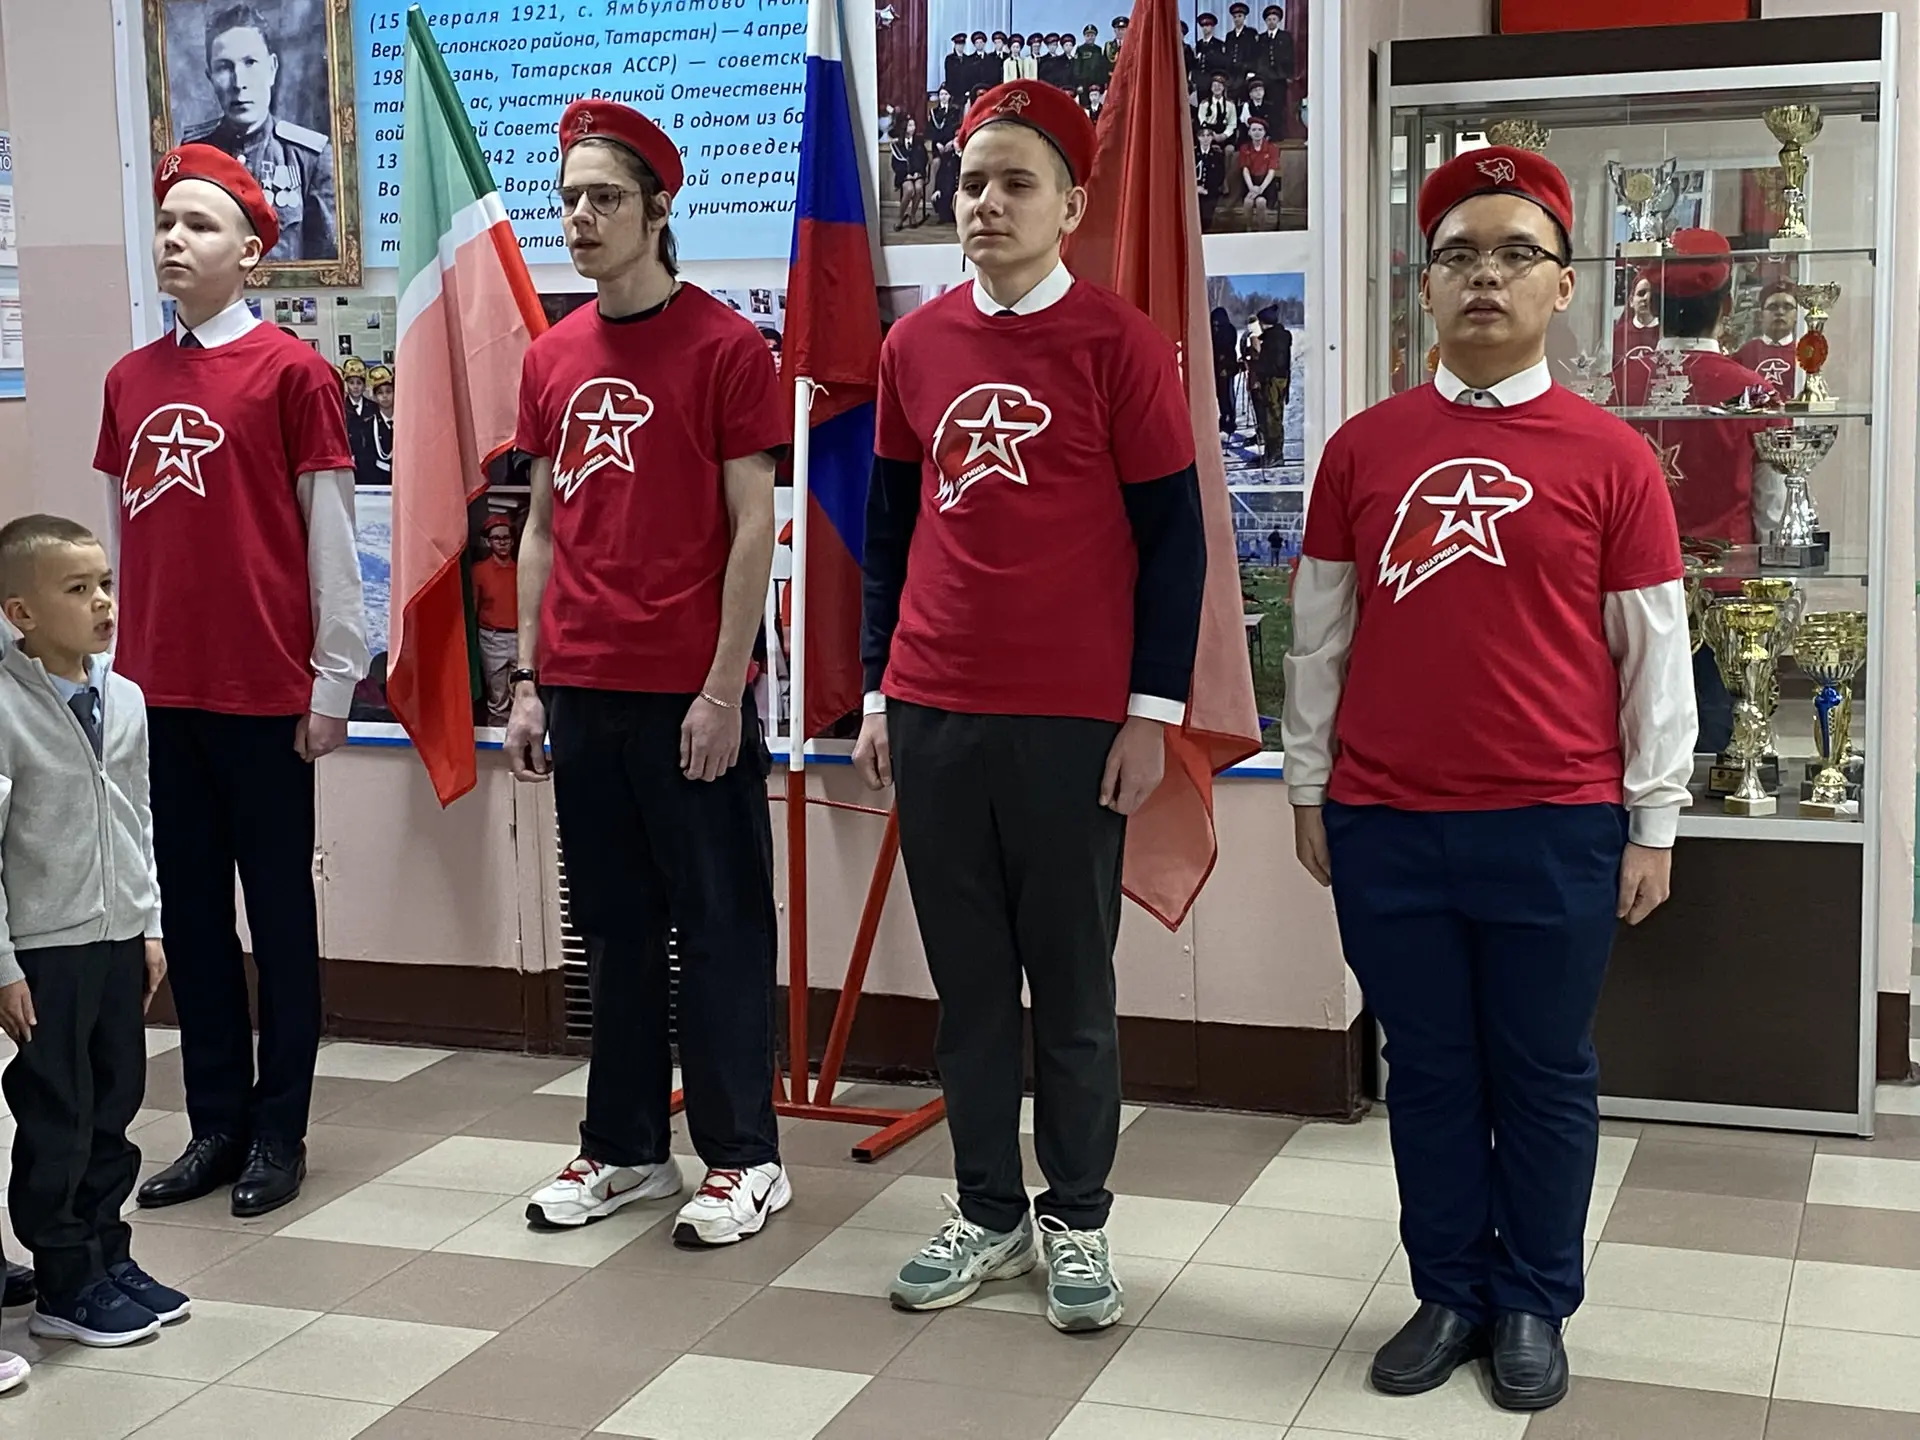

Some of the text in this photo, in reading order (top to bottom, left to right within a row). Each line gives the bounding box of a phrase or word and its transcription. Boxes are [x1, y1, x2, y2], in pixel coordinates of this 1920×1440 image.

[370, 13, 400, 34] (15
[428, 10, 499, 29] евраля
[511, 4, 565, 22] 1921,
[578, 6, 593, 17] с.
[606, 0, 745, 17] Ямбулатово
[531, 33, 599, 53] района,
[605, 22, 717, 46] Татарстан)
[744, 21, 754, 37] 4
[373, 70, 404, 86] 198
[453, 67, 499, 83] зань,
[511, 61, 612, 81] Татарская
[623, 53, 677, 75] АССР)
[470, 96, 493, 111] ас,
[591, 84, 664, 102] Великой
[671, 80, 806, 100] Отечественн
[375, 121, 404, 141] вой
[494, 120, 560, 138] Советс
[673, 113, 685, 129] В
[690, 111, 750, 128] одном
[757, 113, 776, 126] из
[783, 107, 805, 126] бо
[376, 153, 398, 169] 13
[484, 149, 515, 165] 942
[526, 145, 560, 163] год
[701, 137, 801, 160] проведен
[687, 169, 709, 186] ой
[721, 170, 796, 188] операц
[1415, 543, 1460, 575] ЮНАРМИЯ
